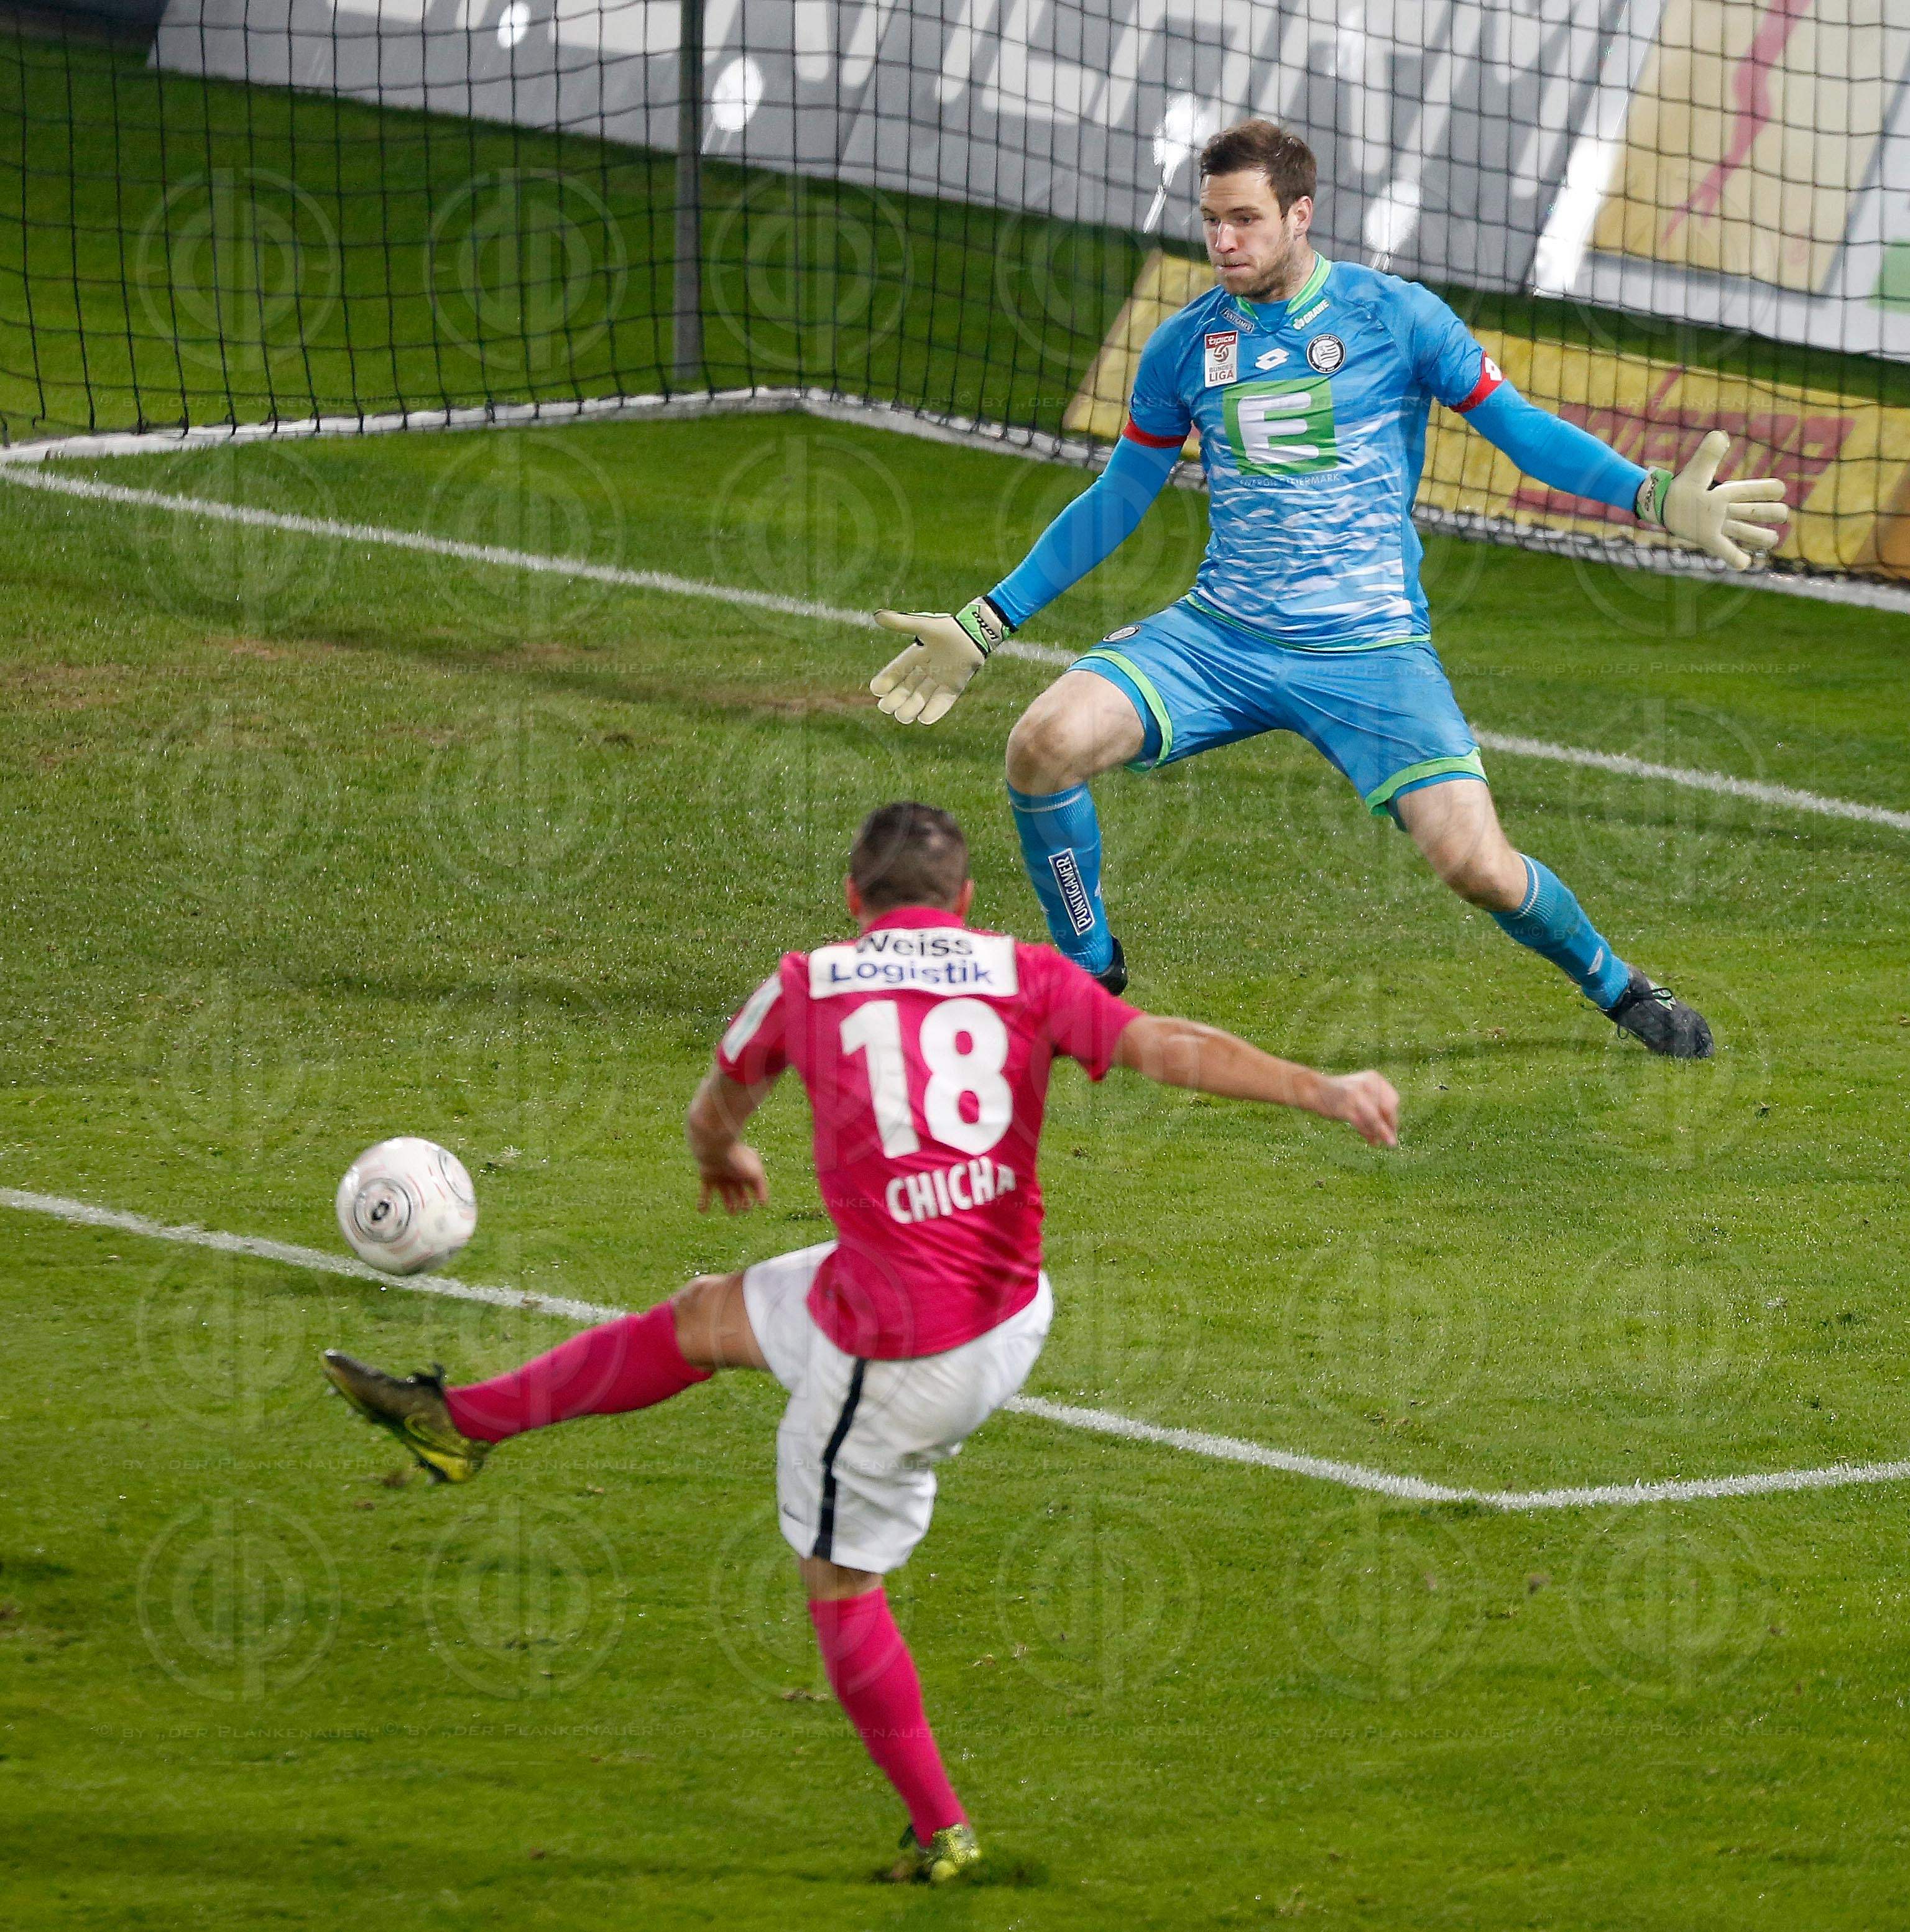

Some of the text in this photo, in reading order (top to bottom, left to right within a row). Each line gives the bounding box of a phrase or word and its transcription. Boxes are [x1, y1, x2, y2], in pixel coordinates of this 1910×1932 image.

[1208, 335, 1235, 346] tipico
[1209, 370, 1234, 382] LIGA
[1237, 392, 1319, 464] E
[1056, 855, 1091, 929] PUNTIGAMER
[856, 932, 972, 956] Weiss
[831, 960, 994, 984] Logistik
[839, 997, 1014, 1159] 18
